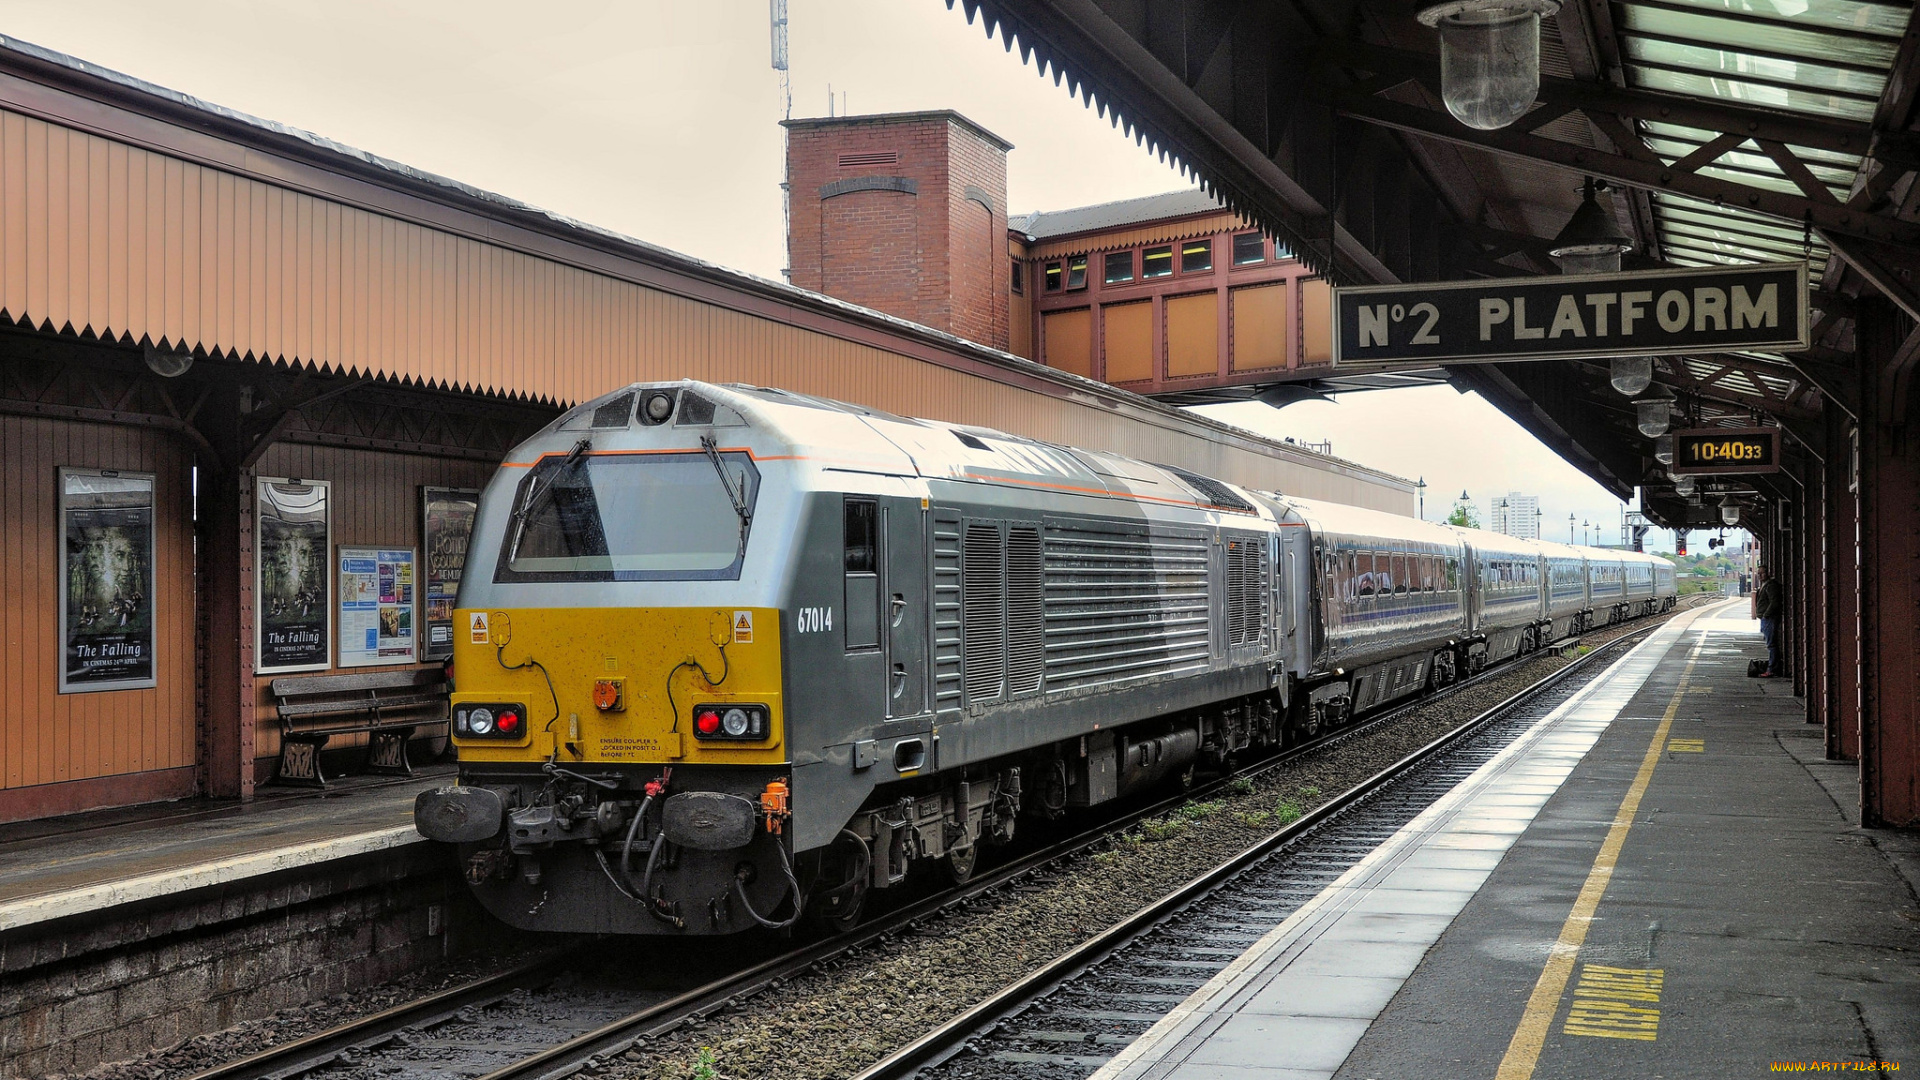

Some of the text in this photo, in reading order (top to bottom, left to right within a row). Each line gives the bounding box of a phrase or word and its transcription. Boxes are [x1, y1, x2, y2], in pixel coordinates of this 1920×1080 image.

[1479, 283, 1778, 341] PLATFORM
[798, 606, 832, 634] 67014
[268, 631, 320, 644] The Falling
[77, 642, 141, 657] The Falling
[90, 659, 113, 667] CINEMAS
[1563, 964, 1664, 1041] KEEP BACK
